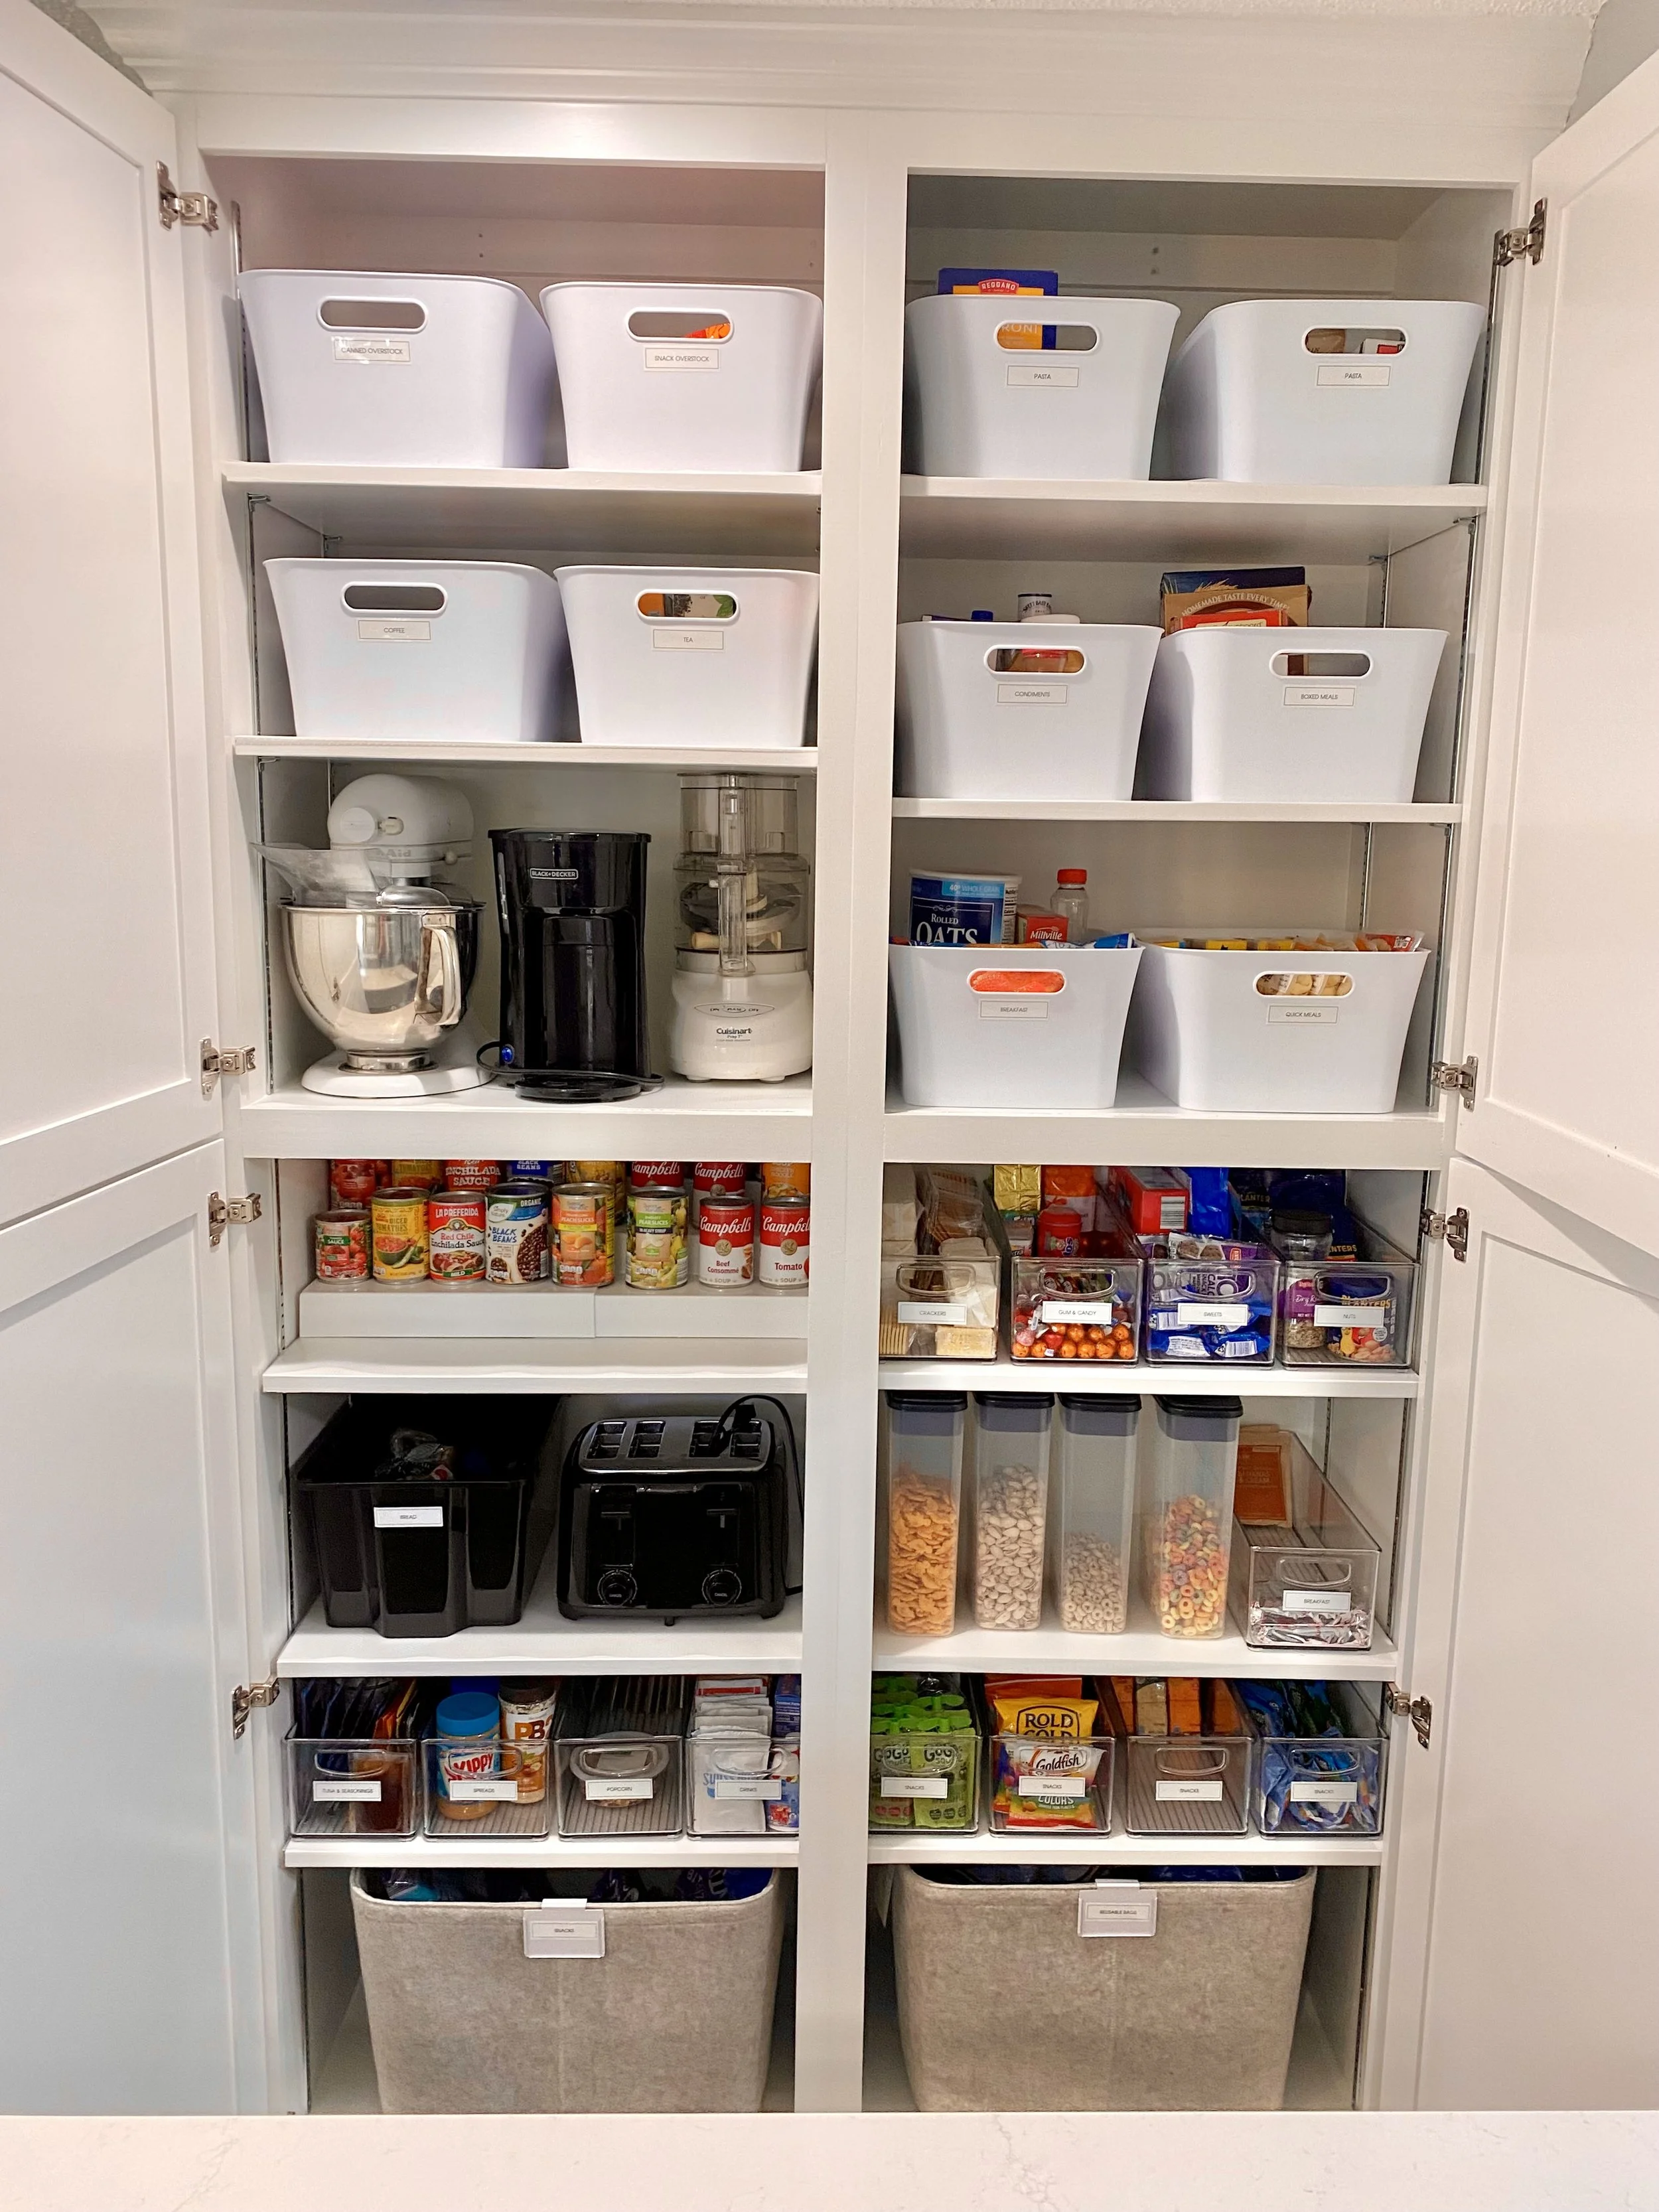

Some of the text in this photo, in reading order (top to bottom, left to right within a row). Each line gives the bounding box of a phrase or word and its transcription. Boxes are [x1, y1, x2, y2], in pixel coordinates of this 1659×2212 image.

[1182, 597, 1222, 617] HOMEMADE
[1223, 593, 1244, 603] TASTE
[1245, 593, 1268, 605] EVERY
[916, 921, 977, 946] OATS
[1030, 930, 1063, 940] Millville
[445, 1166, 502, 1178] ENCHILADA
[453, 1176, 490, 1186] SAUCE
[520, 1198, 542, 1207] ORGANIC
[700, 1216, 752, 1236] Campbell's
[492, 1227, 517, 1236] BLACK
[431, 1238, 465, 1248] Enchilada
[492, 1234, 518, 1244] BEANS
[774, 1262, 803, 1270] Tomato
[1025, 1713, 1074, 1729] ROLD
[1036, 1753, 1080, 1771] Goldfish
